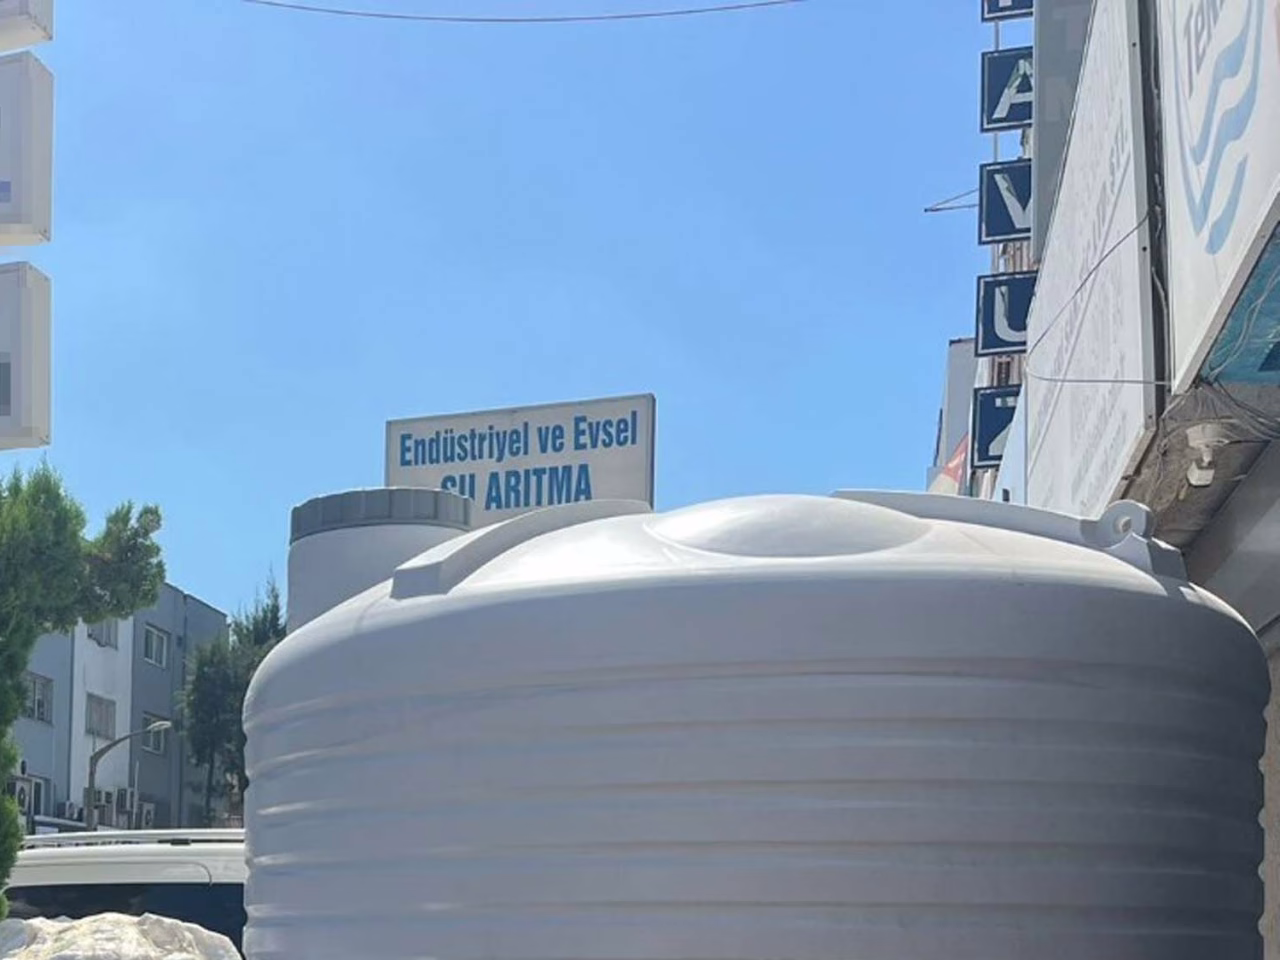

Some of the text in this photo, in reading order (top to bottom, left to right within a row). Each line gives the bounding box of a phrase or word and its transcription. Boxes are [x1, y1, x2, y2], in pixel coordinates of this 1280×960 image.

[400, 410, 638, 467] Endüstriyel ve Evsel
[485, 463, 593, 510] ARITMA
